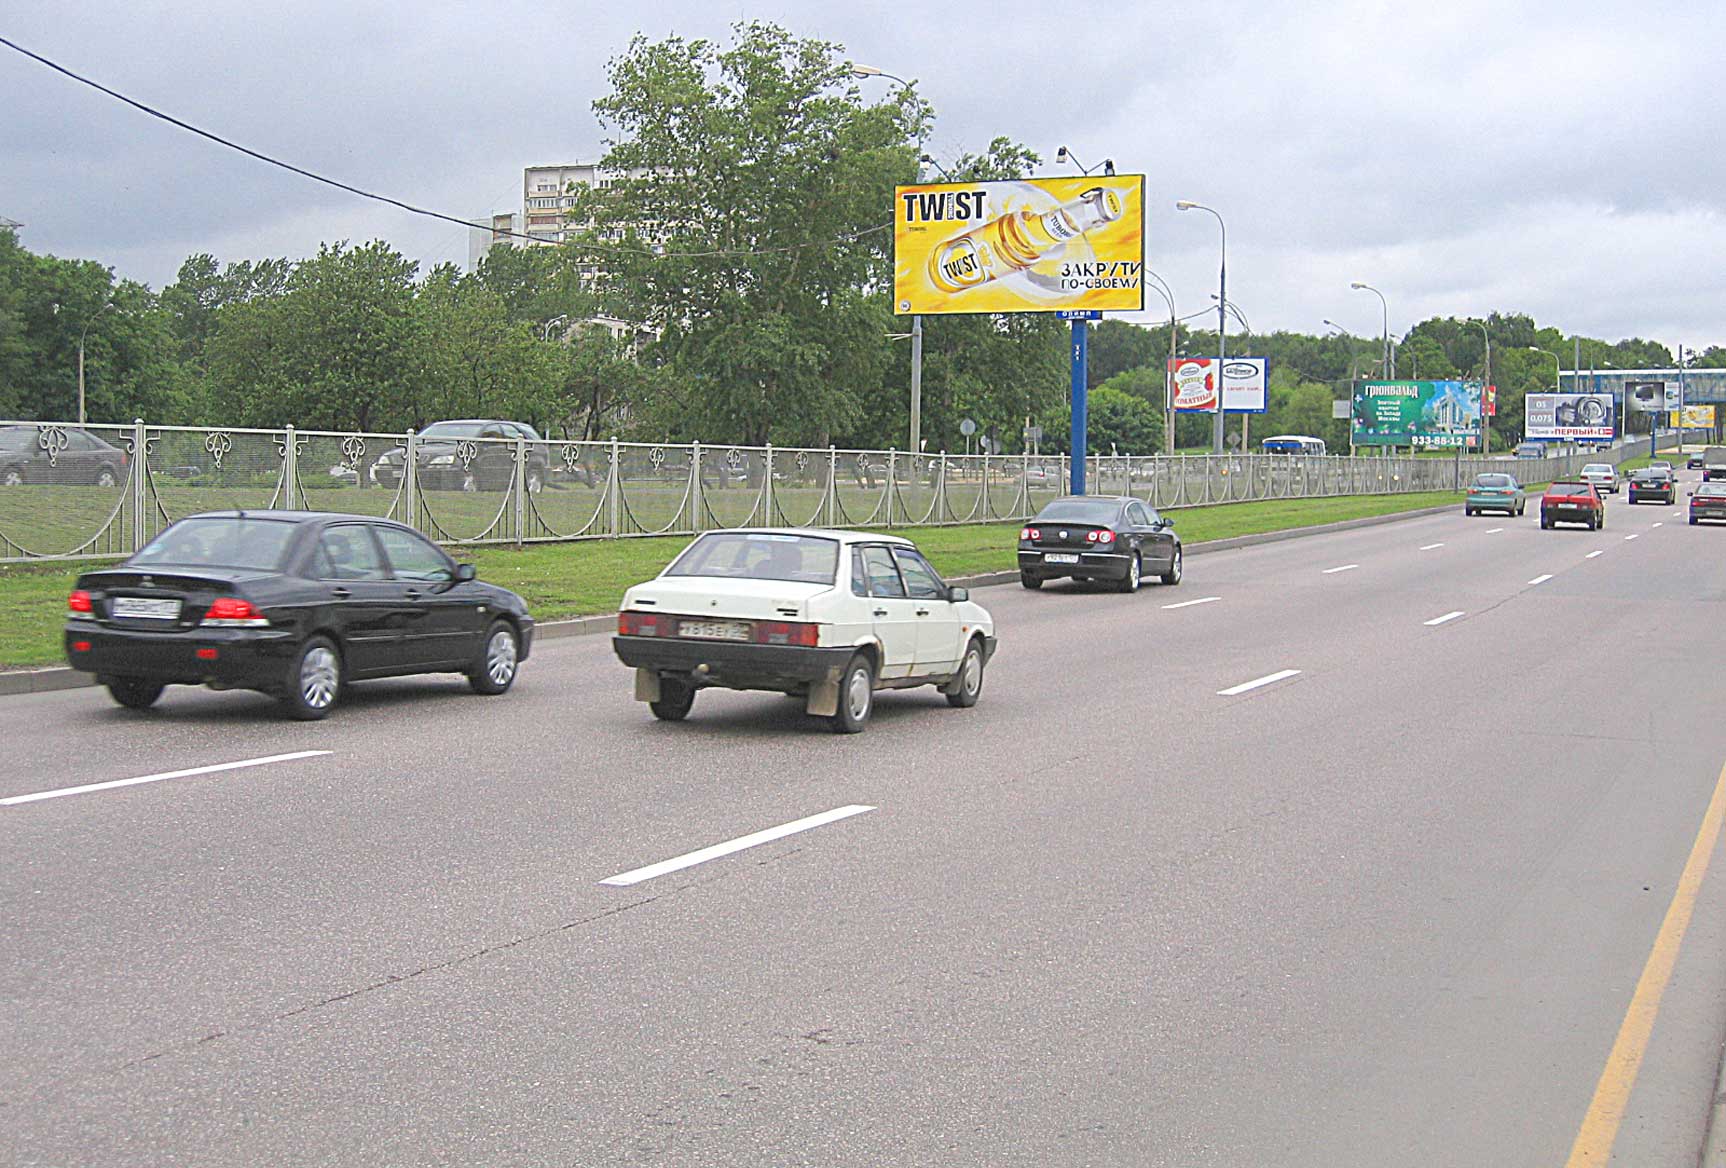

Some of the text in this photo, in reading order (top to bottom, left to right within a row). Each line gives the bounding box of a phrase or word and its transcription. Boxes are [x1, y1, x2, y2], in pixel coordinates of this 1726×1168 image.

[903, 191, 987, 221] TWIST
[943, 253, 978, 279] TWIST
[1061, 262, 1141, 277] ЗАКРУТИ
